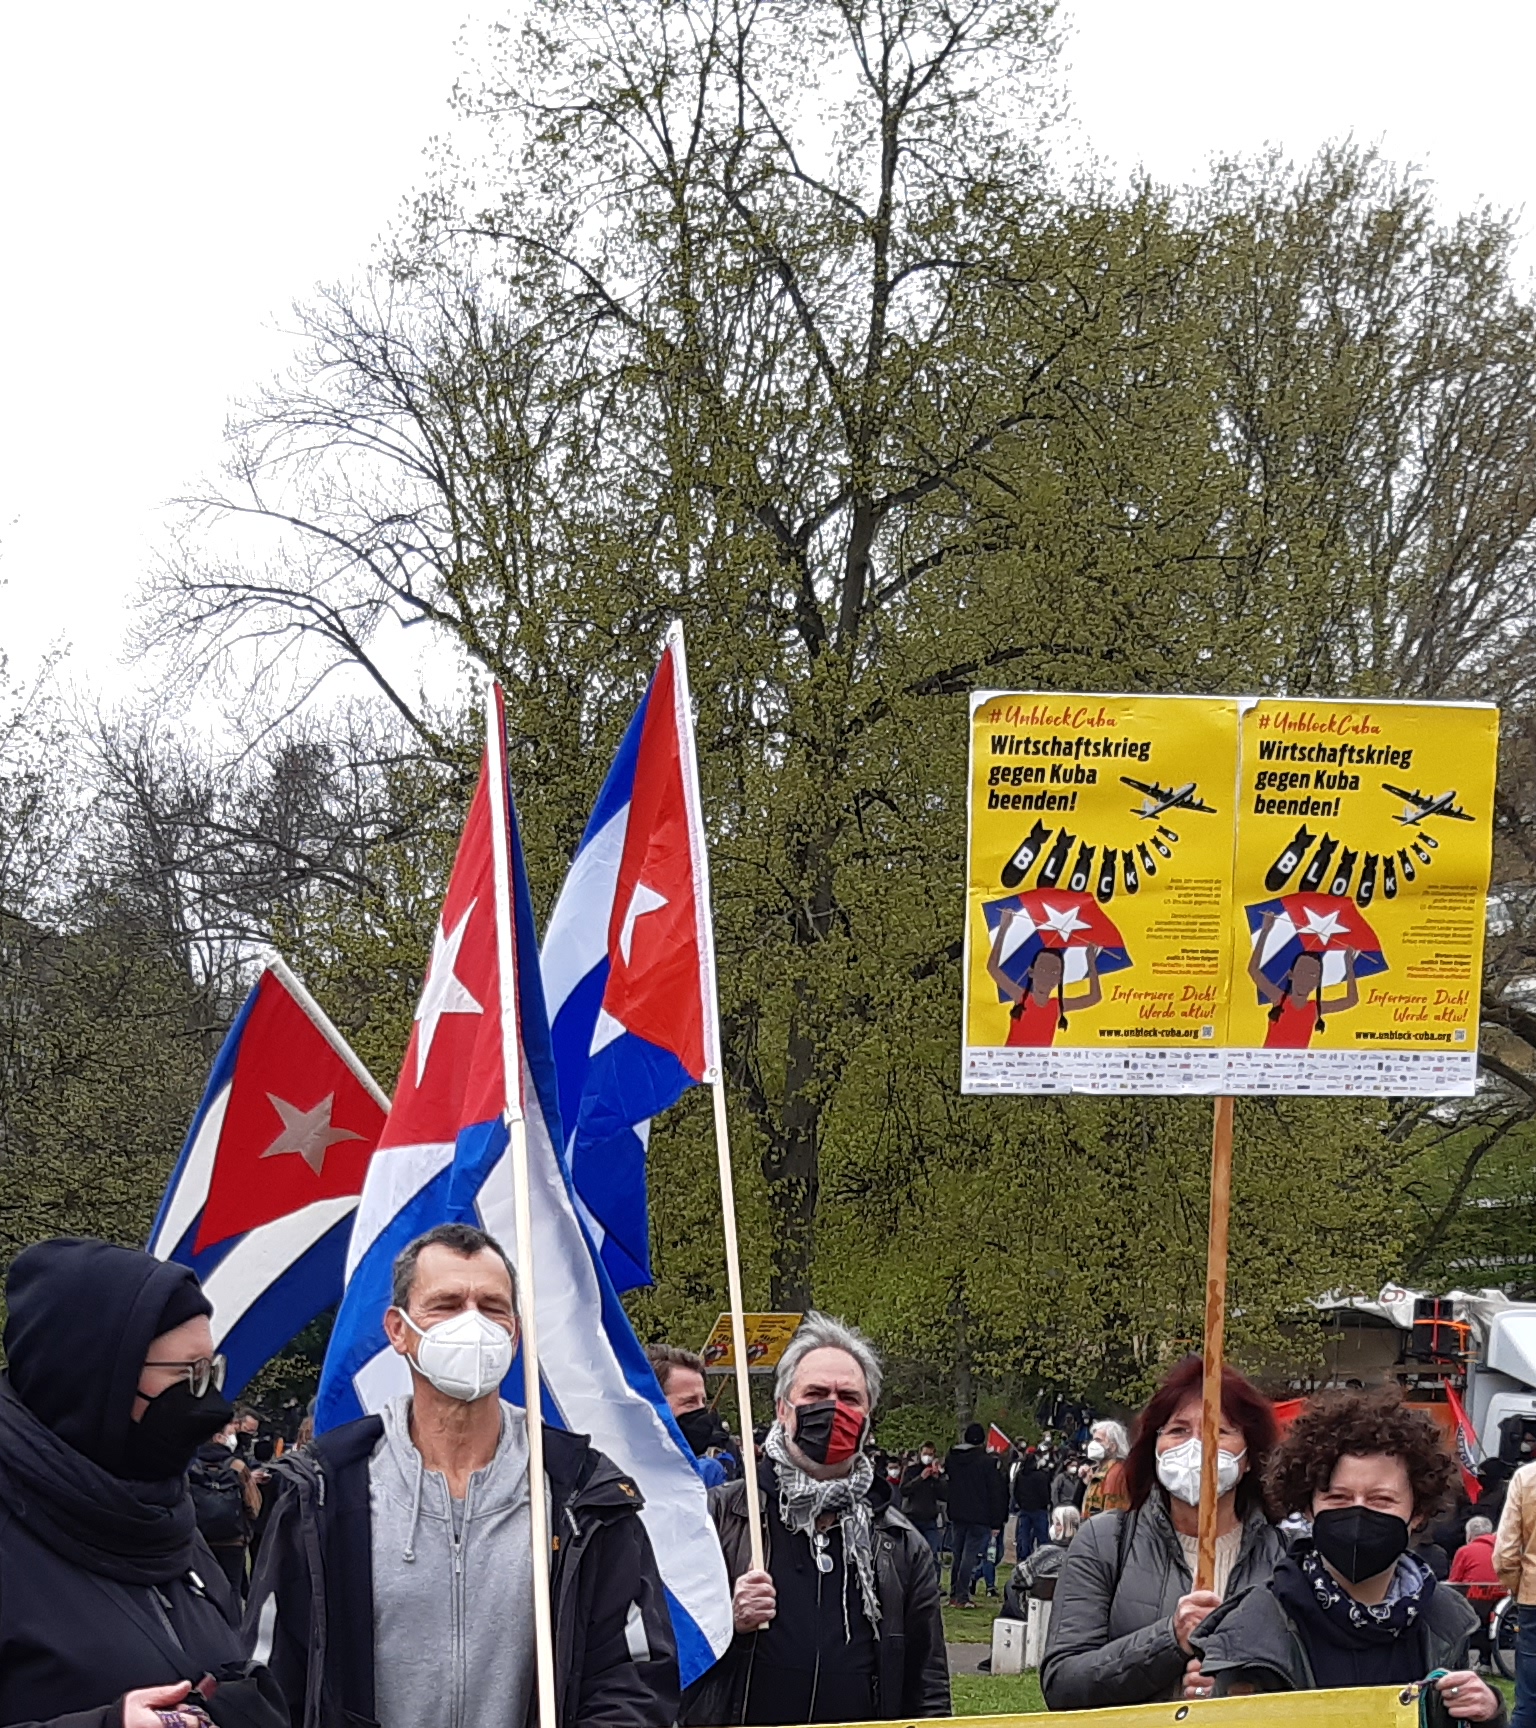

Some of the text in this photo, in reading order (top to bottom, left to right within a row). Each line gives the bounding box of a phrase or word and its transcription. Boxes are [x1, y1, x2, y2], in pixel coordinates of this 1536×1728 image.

[989, 705, 1117, 728] #UnblockCuba
[1259, 712, 1382, 735] #UnblockCuba
[991, 735, 1151, 761] Wirtschaftskrieg
[1259, 741, 1413, 769] Wirtschaftskrieg
[988, 764, 1097, 786] gegen Kuba
[1255, 770, 1360, 791] gegen Kuba
[988, 790, 1077, 811] beenden!
[1254, 795, 1341, 817] beenden!
[1179, 985, 1218, 1002] Dich!
[1433, 989, 1469, 1005] Dich!
